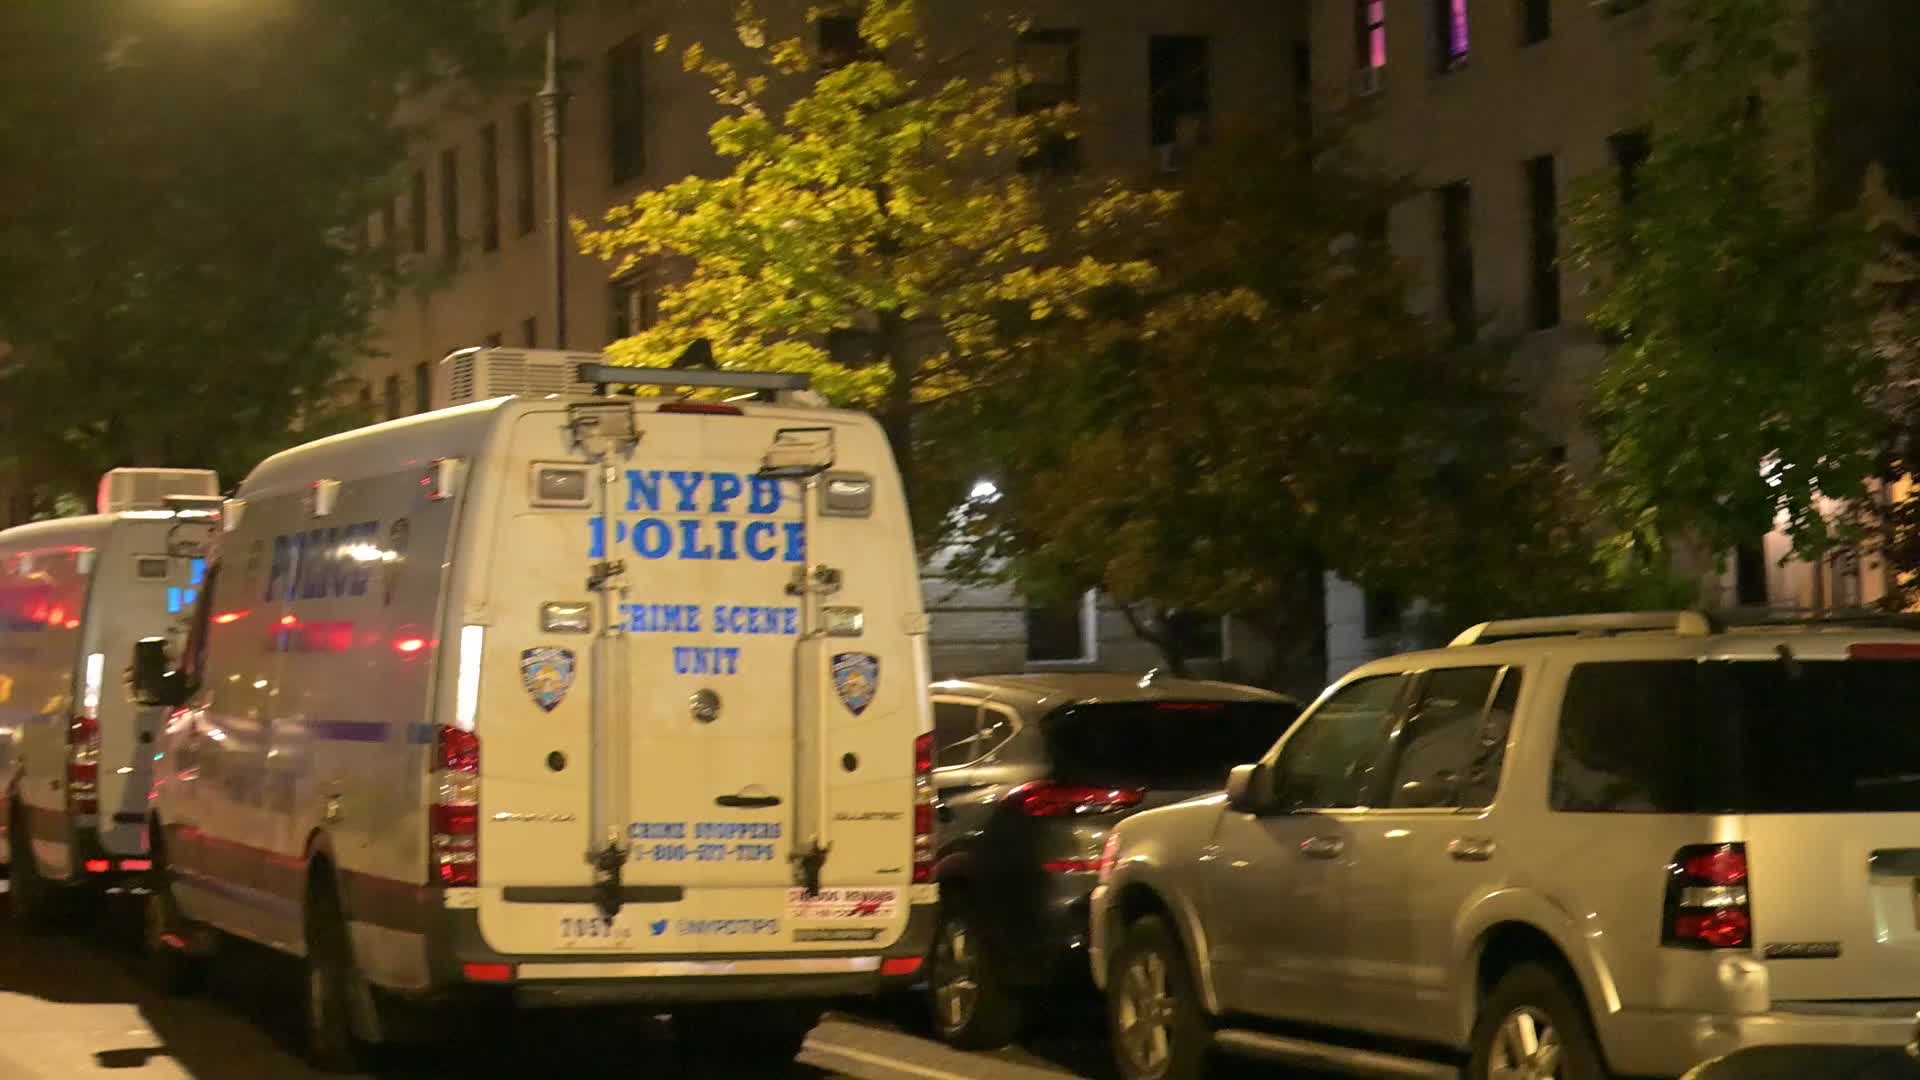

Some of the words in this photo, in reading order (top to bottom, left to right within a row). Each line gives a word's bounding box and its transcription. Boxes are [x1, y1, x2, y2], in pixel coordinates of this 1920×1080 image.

[625, 469, 782, 514] NYPD
[713, 606, 798, 634] SCENE
[673, 646, 739, 674] UNIT
